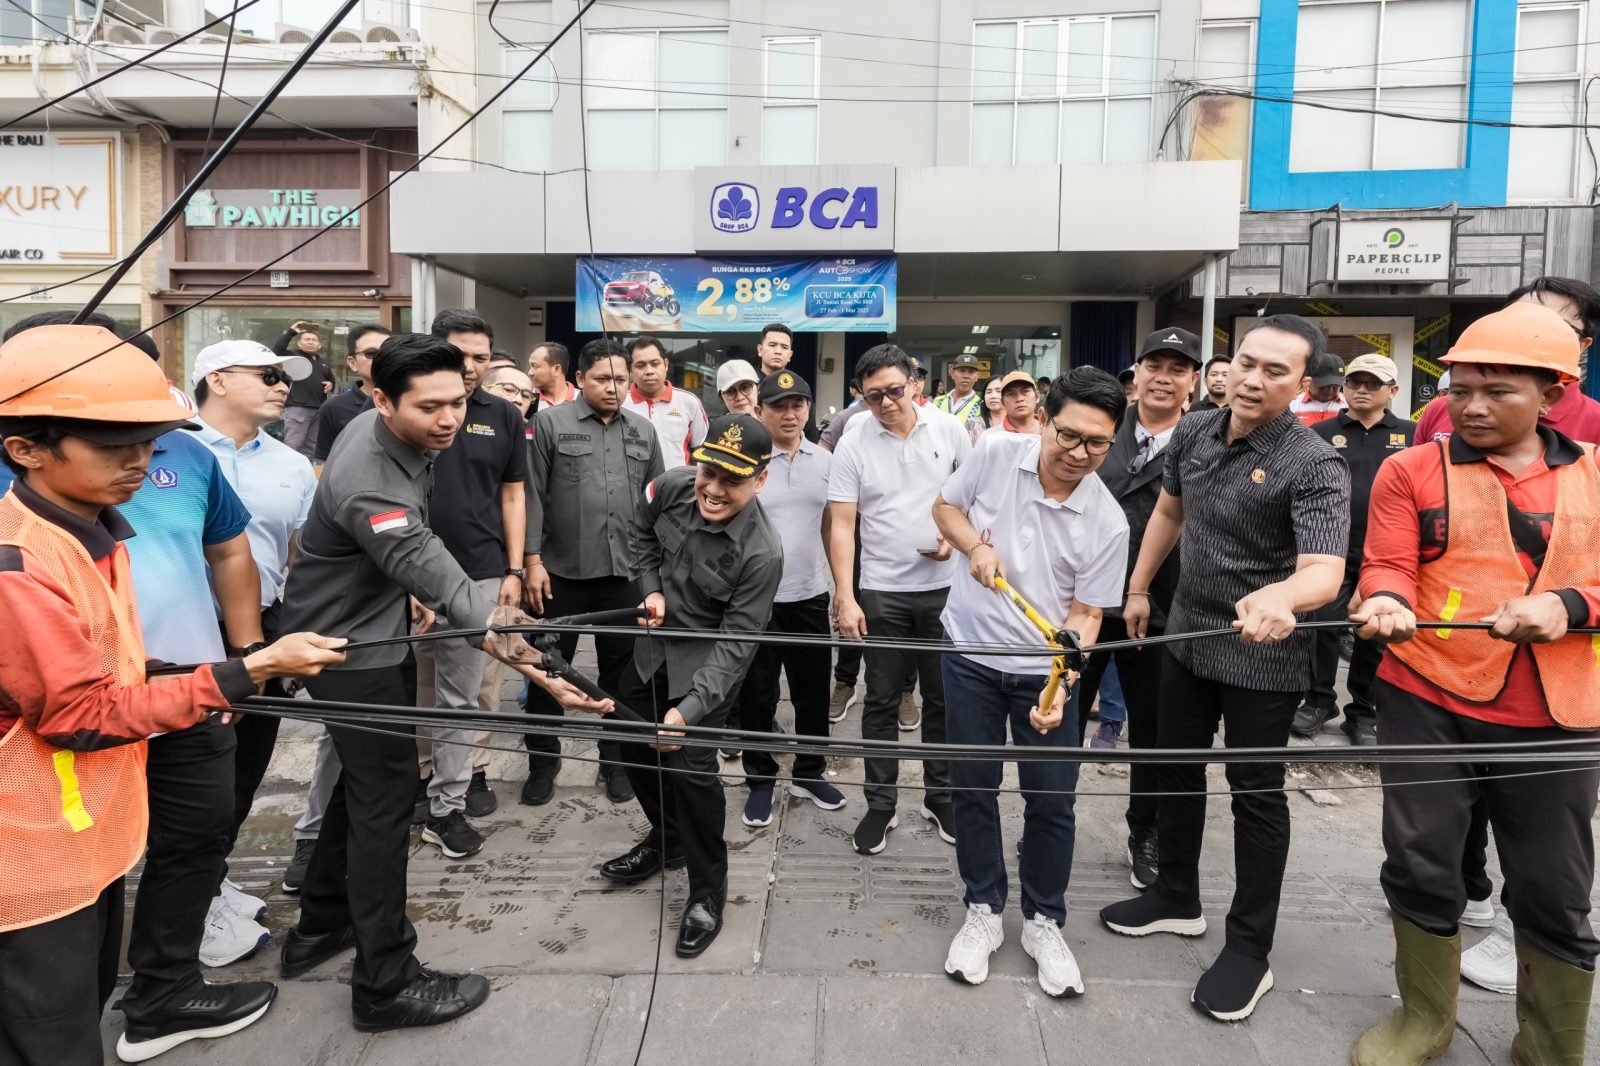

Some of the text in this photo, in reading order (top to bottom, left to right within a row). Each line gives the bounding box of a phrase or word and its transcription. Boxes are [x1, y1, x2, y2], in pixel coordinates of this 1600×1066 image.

[17, 135, 44, 146] BALI
[269, 189, 317, 205] THE
[770, 186, 878, 230] BCA
[223, 205, 360, 227] PAWHIGH
[24, 249, 43, 259] CO
[1346, 253, 1442, 264] PAPERCLIP
[813, 290, 877, 299] KCU BCA KUTA
[1420, 318, 1447, 337] MOVING
